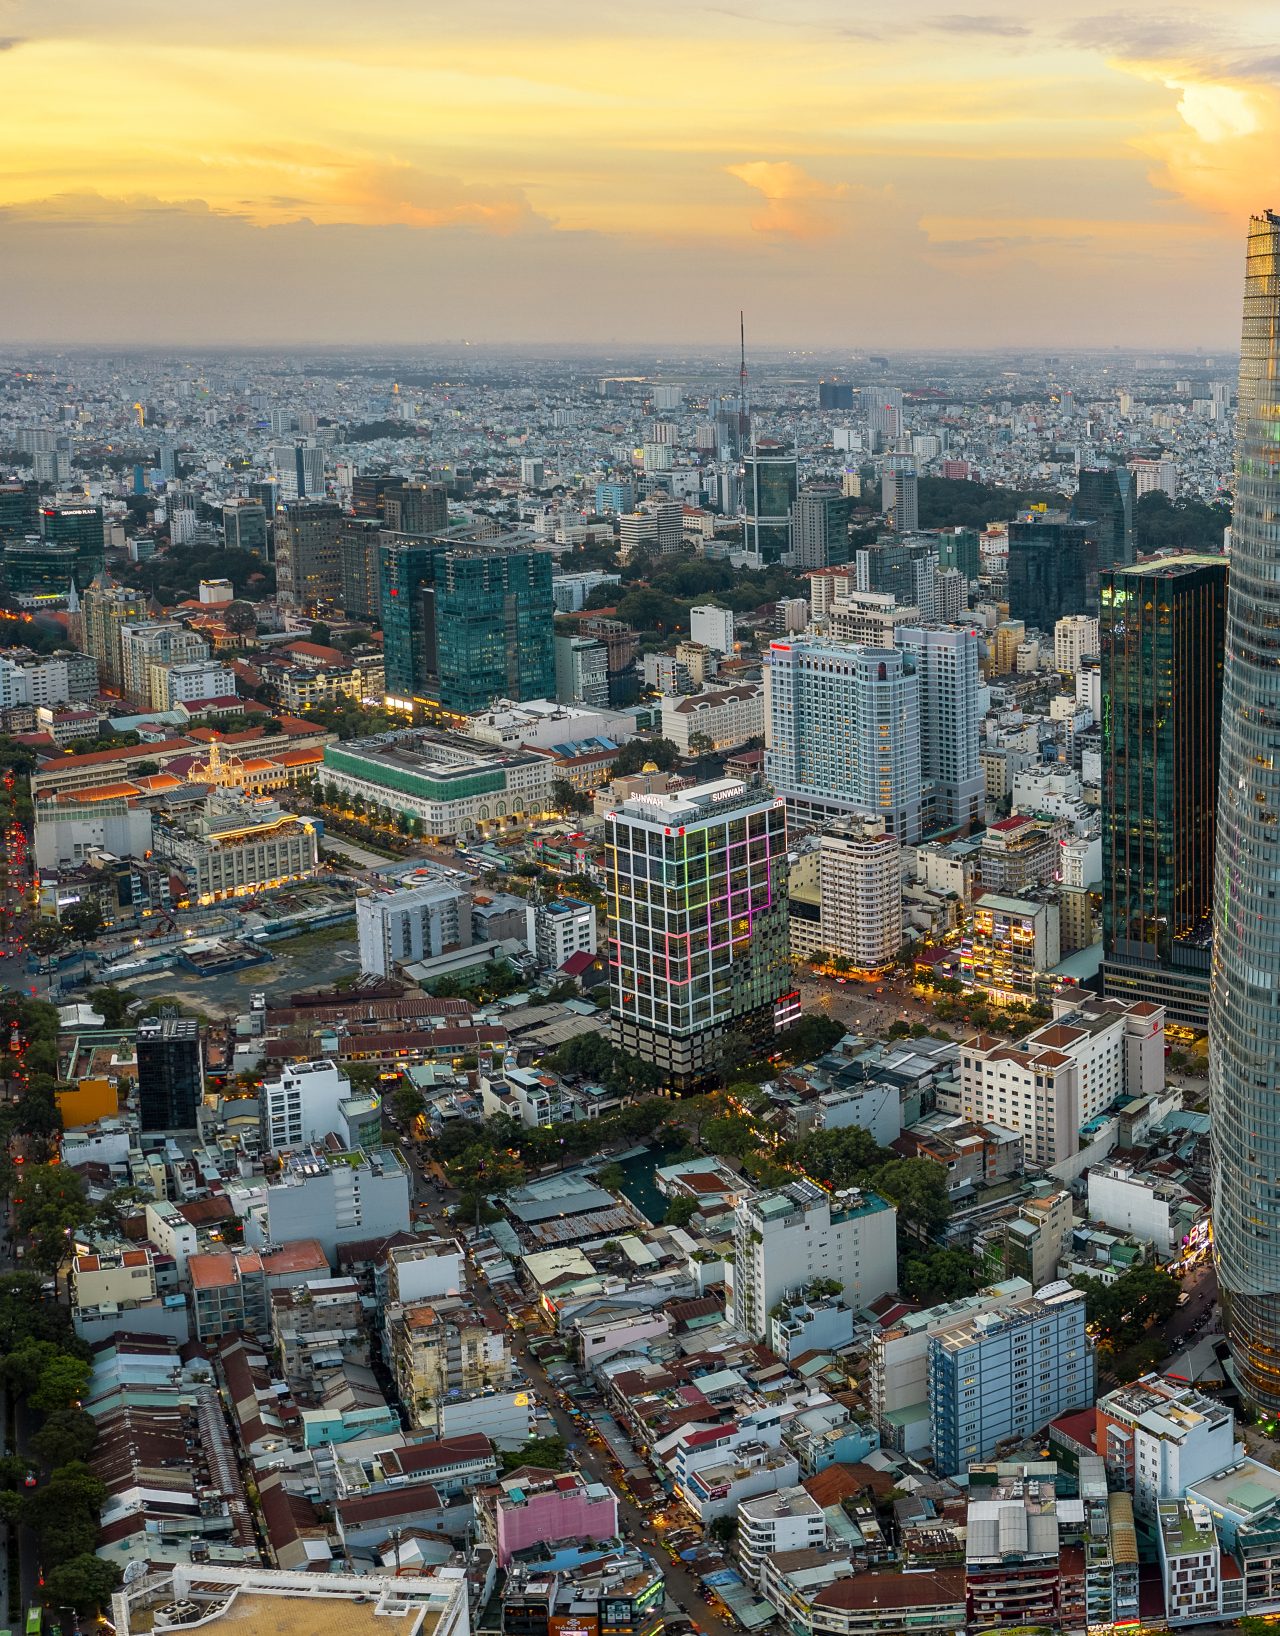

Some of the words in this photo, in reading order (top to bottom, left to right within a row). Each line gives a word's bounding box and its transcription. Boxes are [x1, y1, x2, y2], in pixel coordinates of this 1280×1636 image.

[630, 791, 664, 807] SUNWAH
[712, 785, 744, 802] SUNWAH
[773, 798, 783, 808] citi
[605, 812, 617, 822] citi
